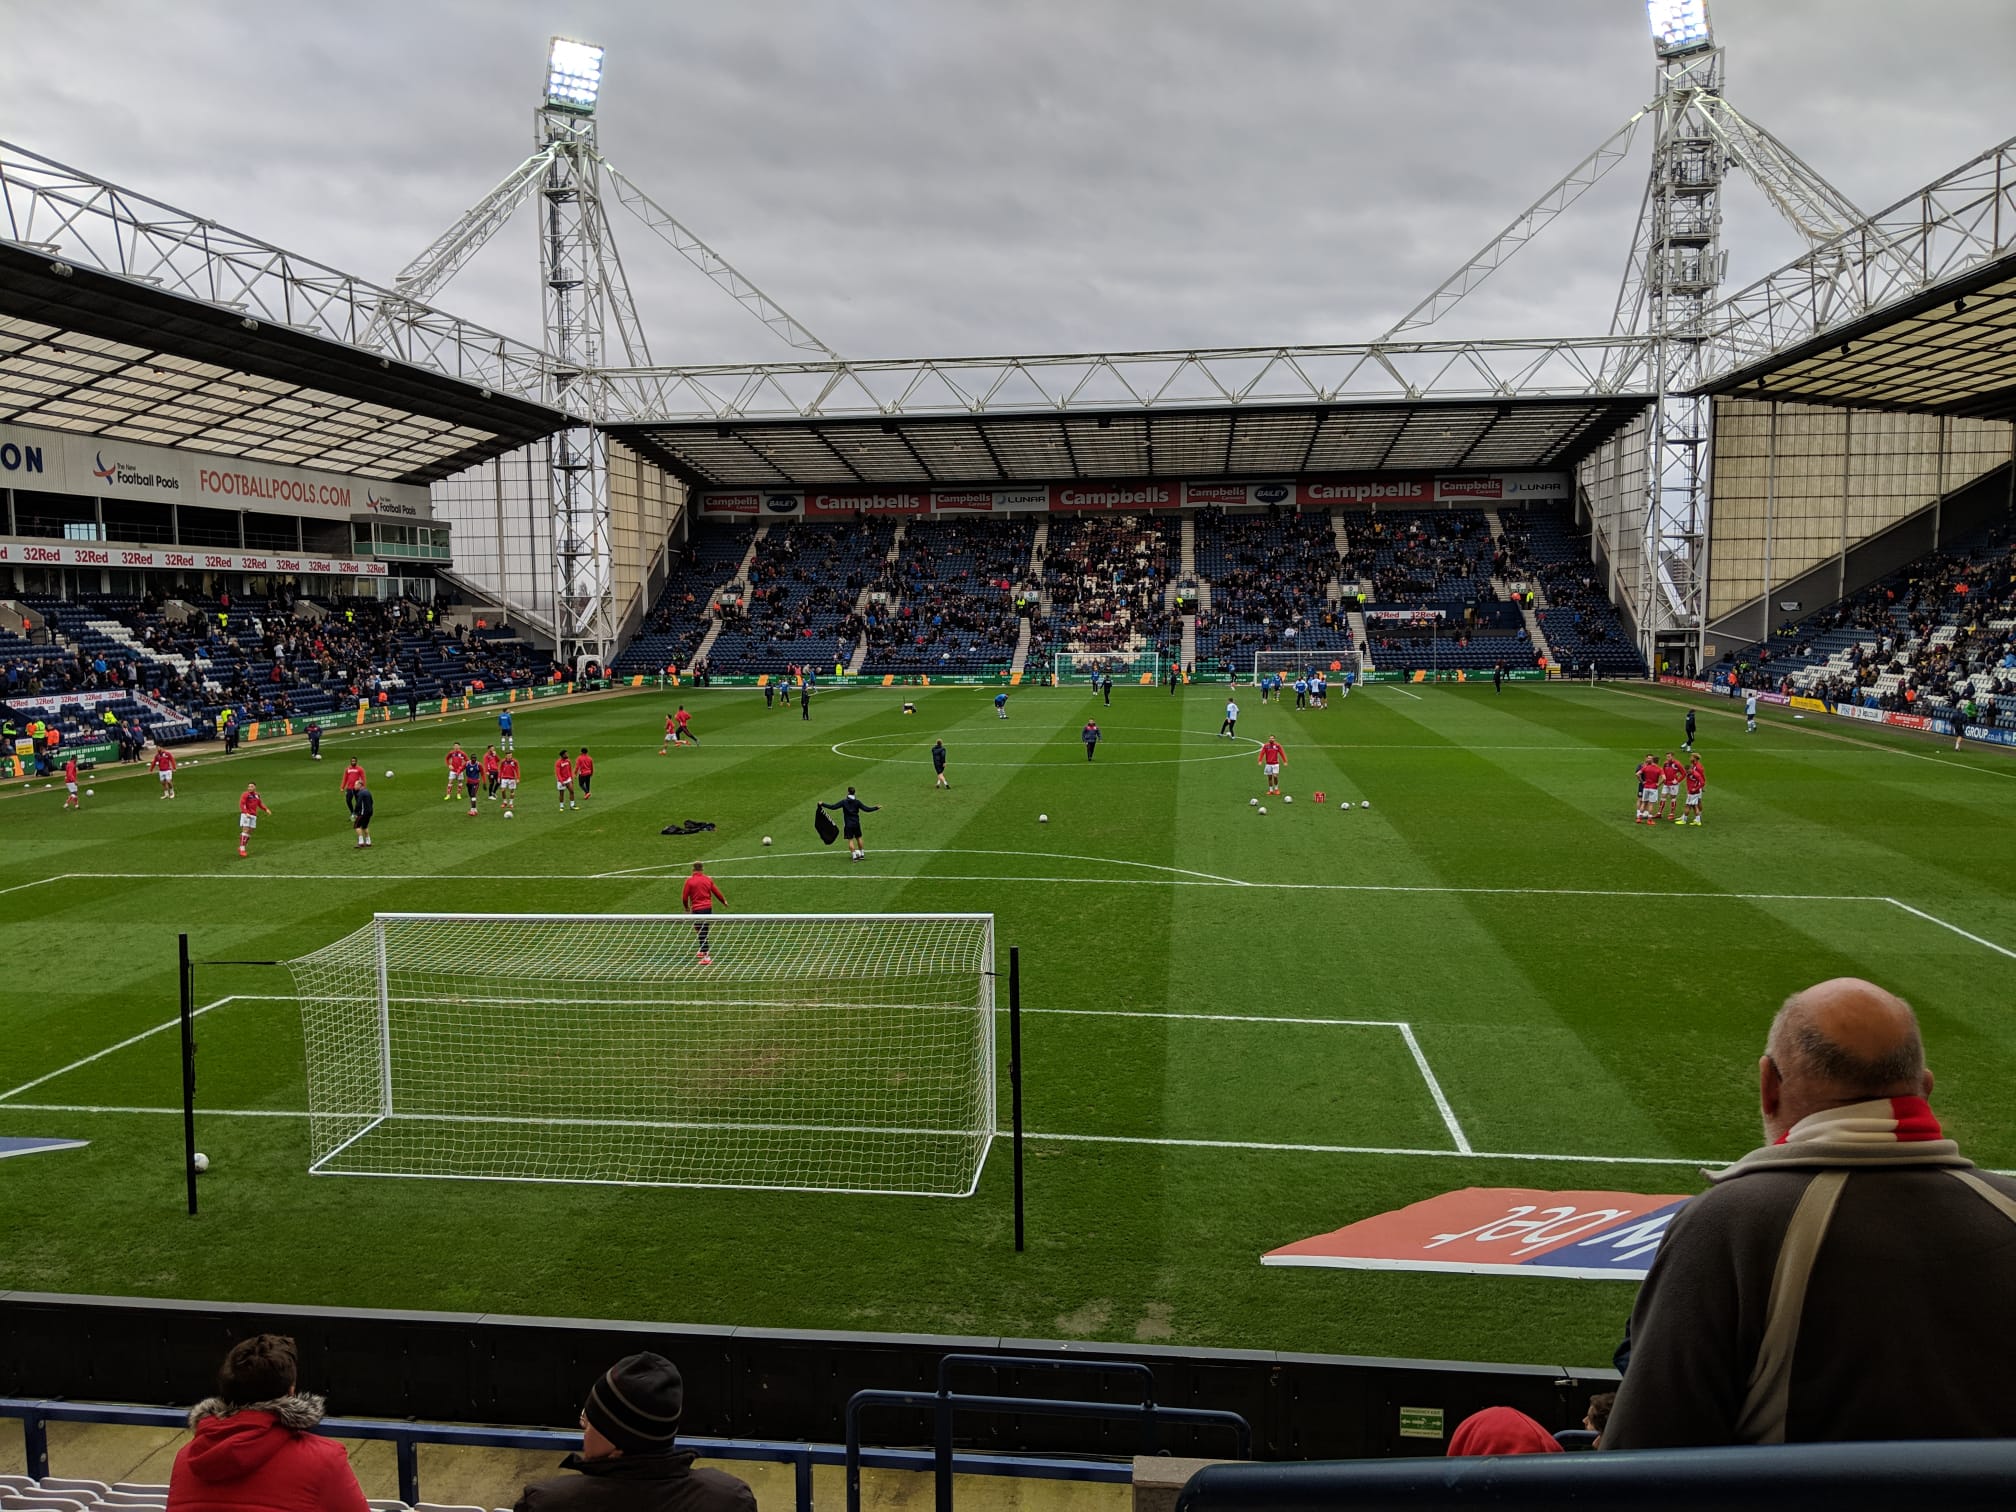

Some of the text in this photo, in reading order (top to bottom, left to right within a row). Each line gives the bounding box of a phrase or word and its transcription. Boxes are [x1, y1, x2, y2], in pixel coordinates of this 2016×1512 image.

[117, 471, 179, 489] Football Pools
[1441, 480, 1501, 492] Campbells
[200, 469, 350, 508] FOOTBALLPOOLS.COM
[1188, 487, 1245, 498] Campbells
[1256, 489, 1286, 497] BAILEY
[1308, 482, 1422, 502] Campbells
[1519, 483, 1561, 491] LUNAR
[705, 496, 758, 507] Campbells
[768, 499, 796, 507] BAILEY
[816, 494, 920, 513] Campbells
[937, 494, 991, 505] Campbells
[1060, 487, 1169, 510] Campbells
[380, 503, 416, 515] Football Pools
[24, 548, 60, 561] 32Red
[75, 550, 108, 563] 32Red
[122, 552, 152, 565] 32Red
[165, 554, 194, 566] 32Red
[205, 556, 232, 568] 32Red
[242, 557, 267, 569] 32Red
[276, 560, 299, 570] 32Red
[309, 561, 330, 572] 32Red
[339, 562, 359, 572] 32Red
[366, 564, 385, 573] 32Red
